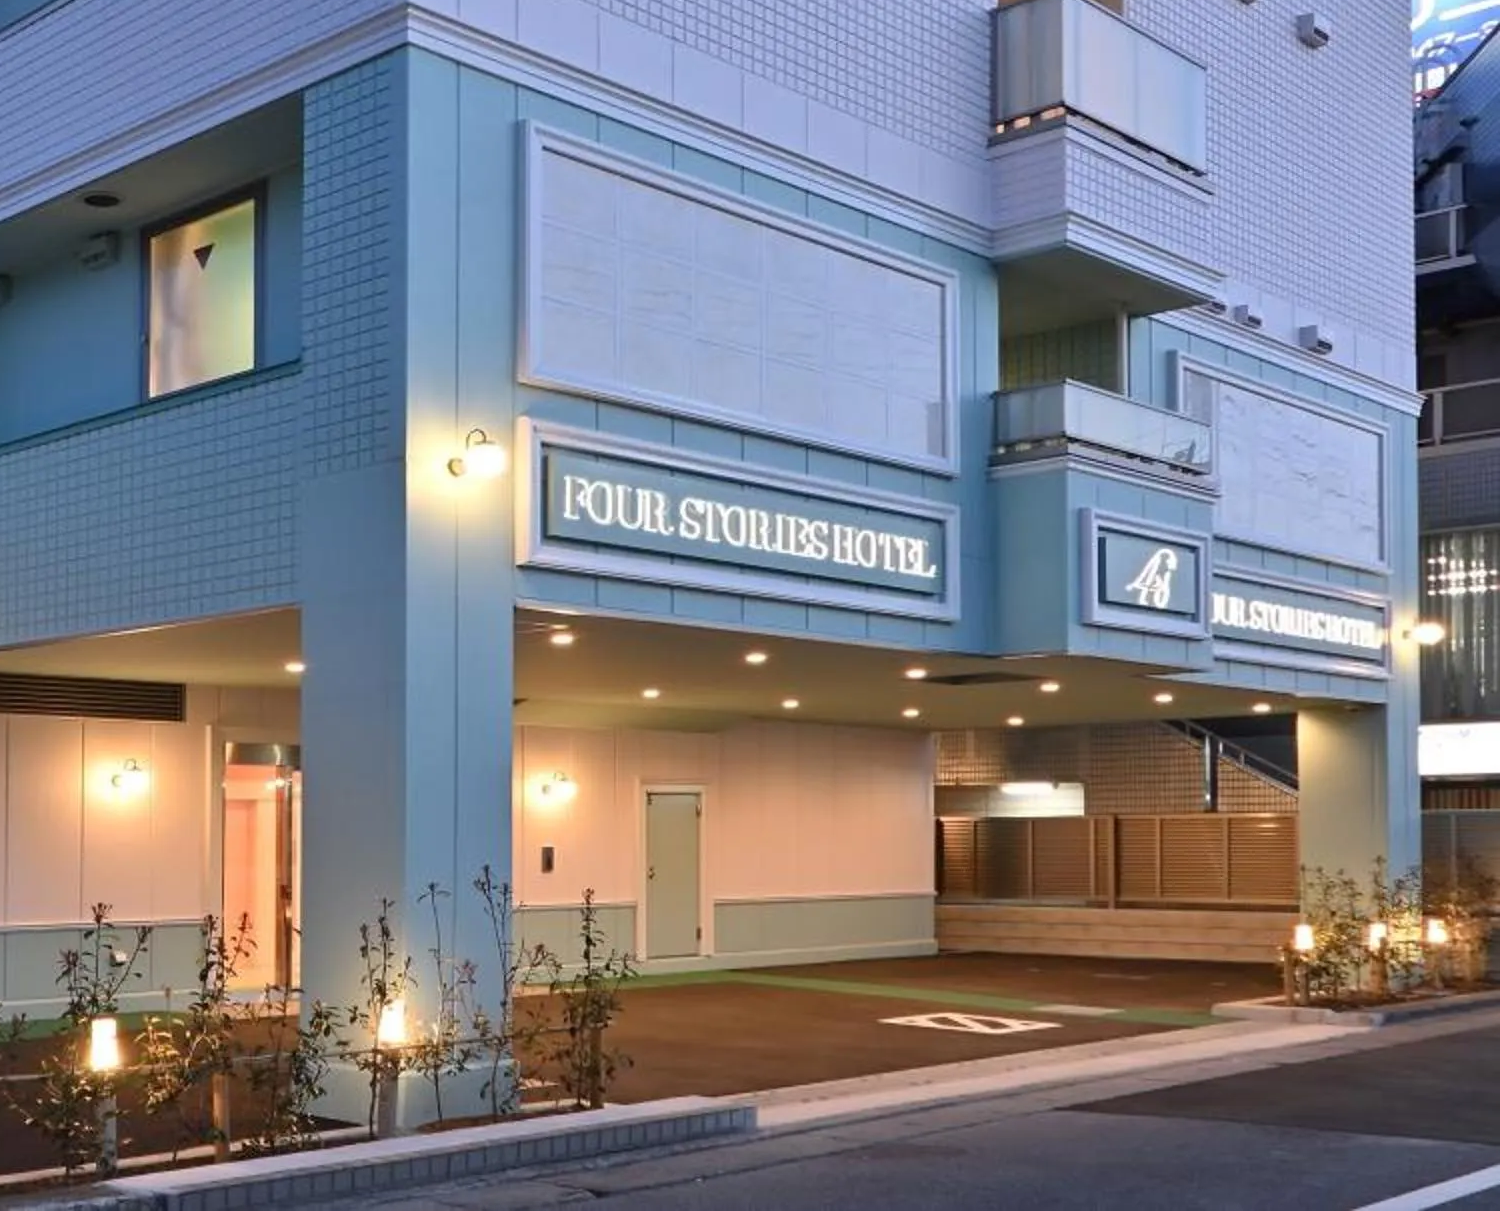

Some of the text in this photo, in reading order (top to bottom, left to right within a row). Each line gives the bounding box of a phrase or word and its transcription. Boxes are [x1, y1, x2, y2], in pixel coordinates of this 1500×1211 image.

[563, 475, 937, 578] FOUR STORIES HOTEL
